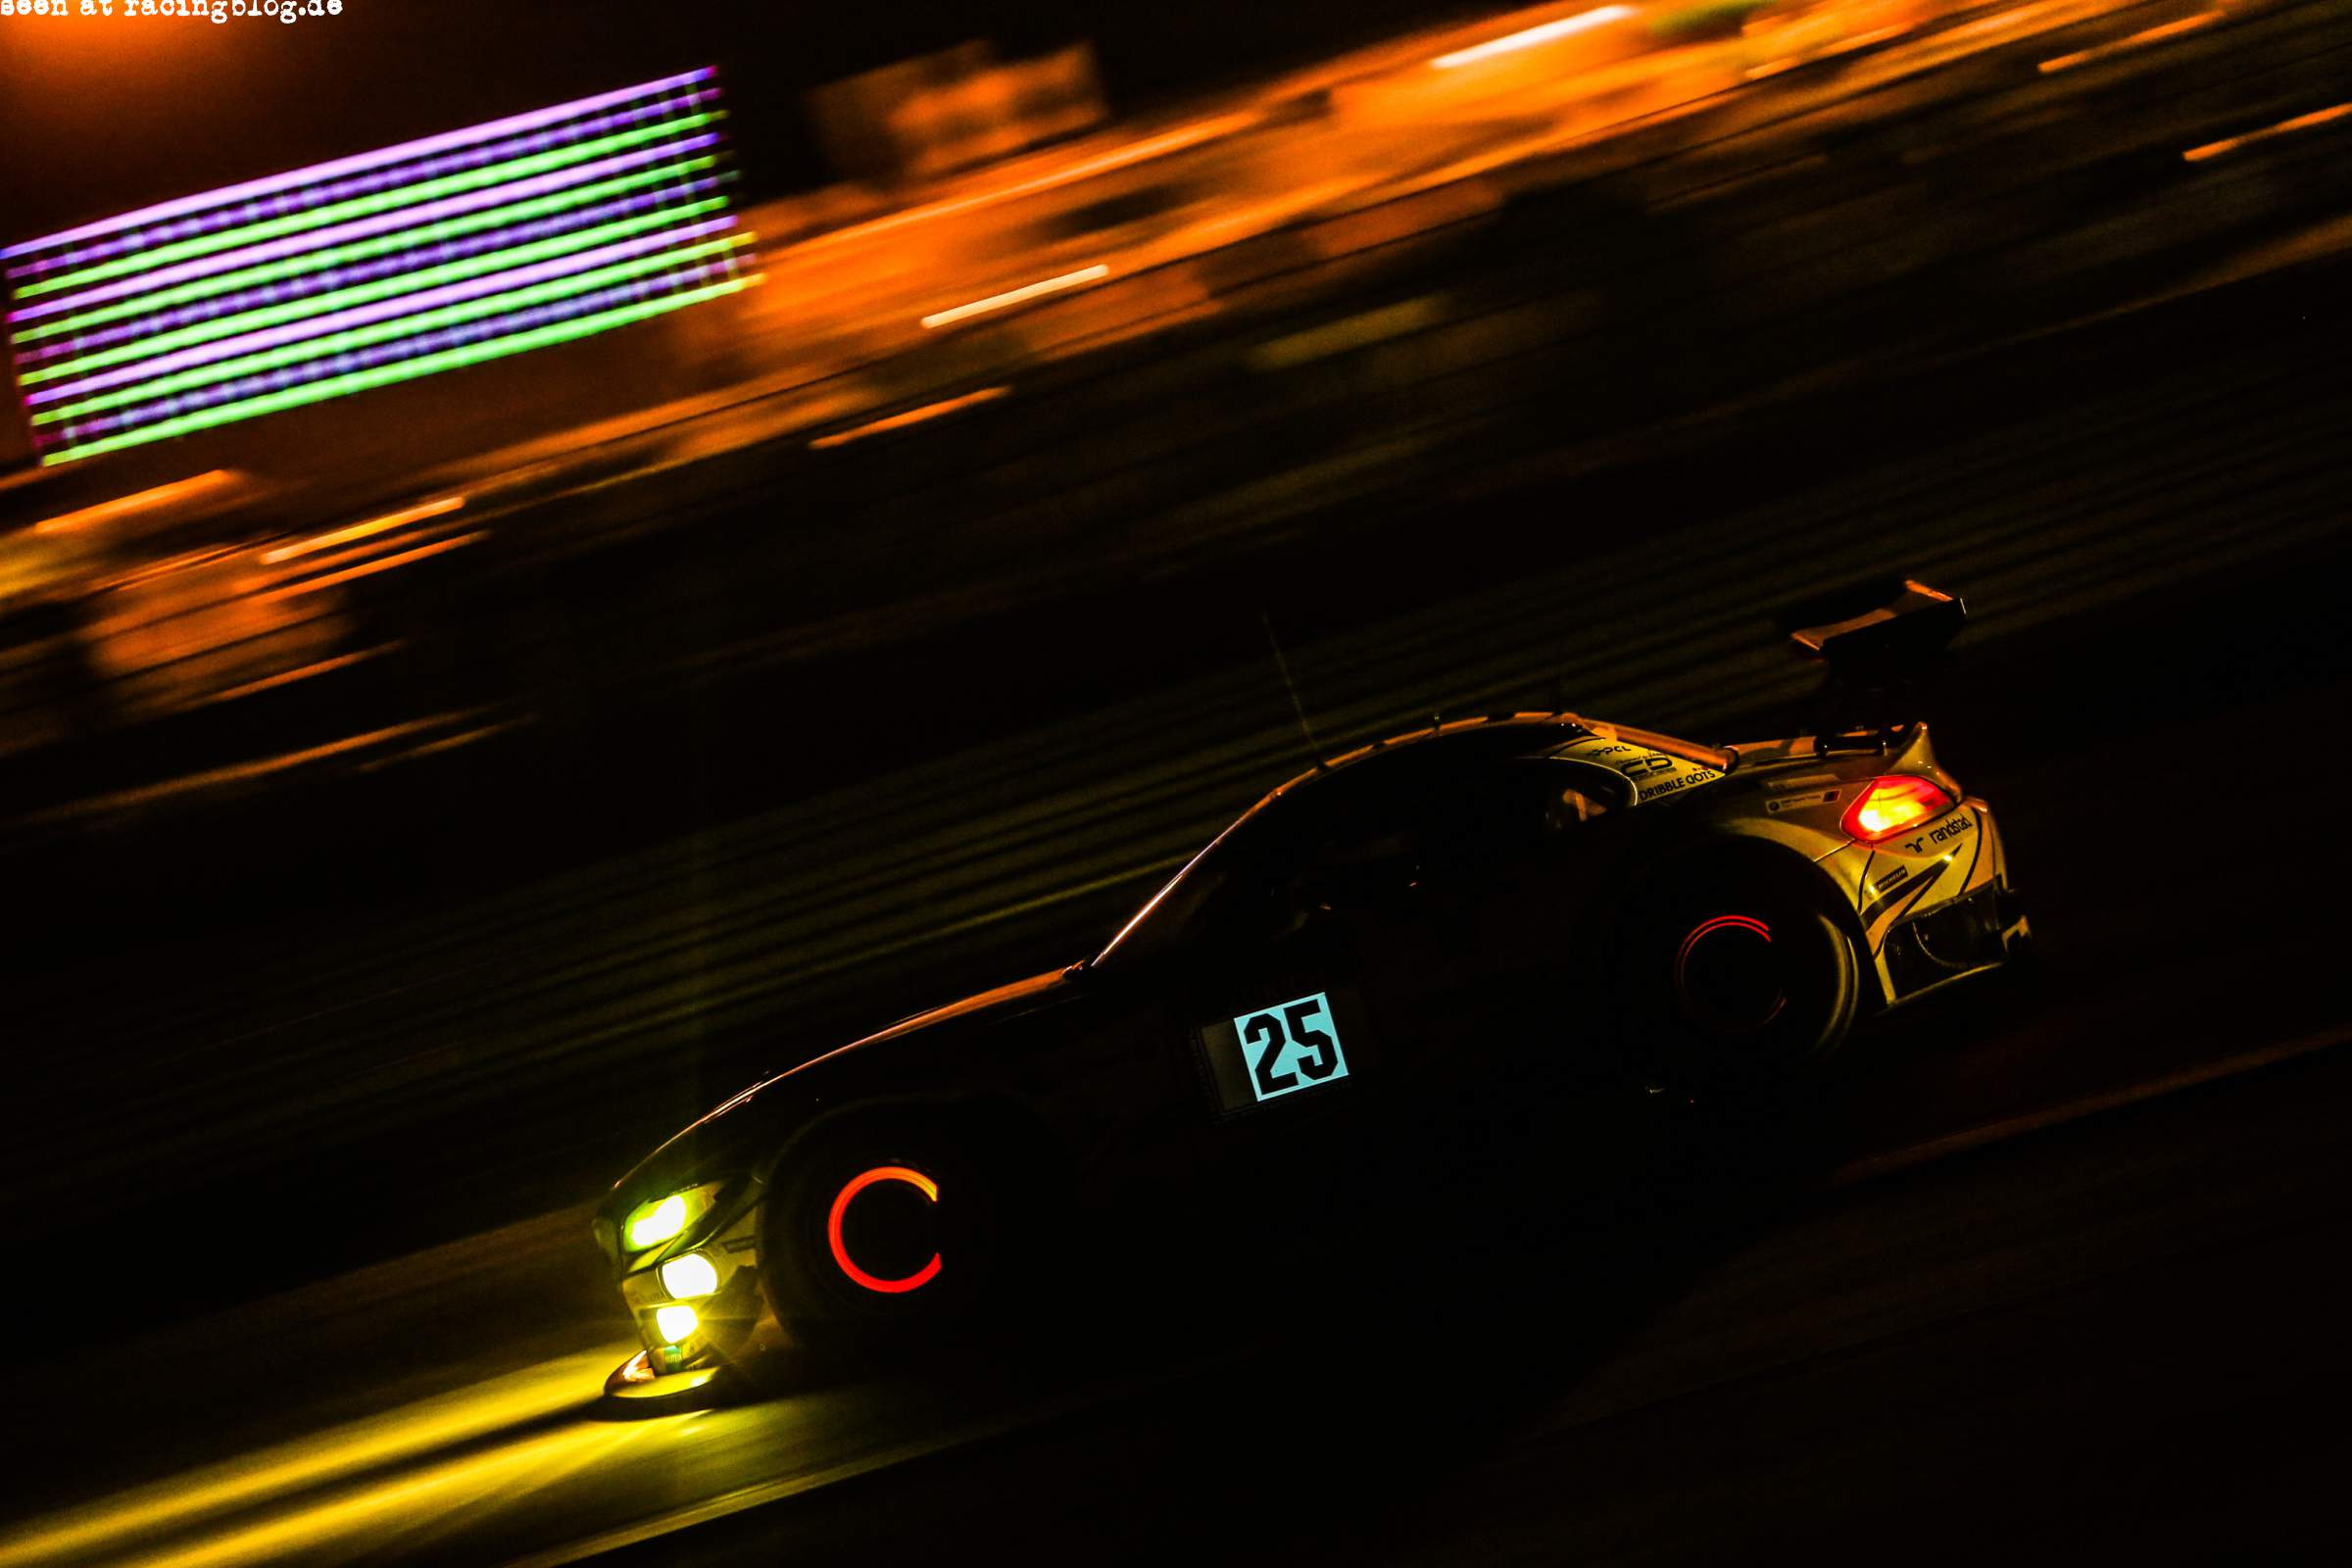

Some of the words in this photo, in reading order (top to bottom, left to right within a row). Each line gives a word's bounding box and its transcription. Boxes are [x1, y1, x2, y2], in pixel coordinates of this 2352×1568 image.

[1639, 777, 1685, 801] DRIBBLE
[1929, 813, 1973, 844] randstad
[1244, 999, 1339, 1096] 25
